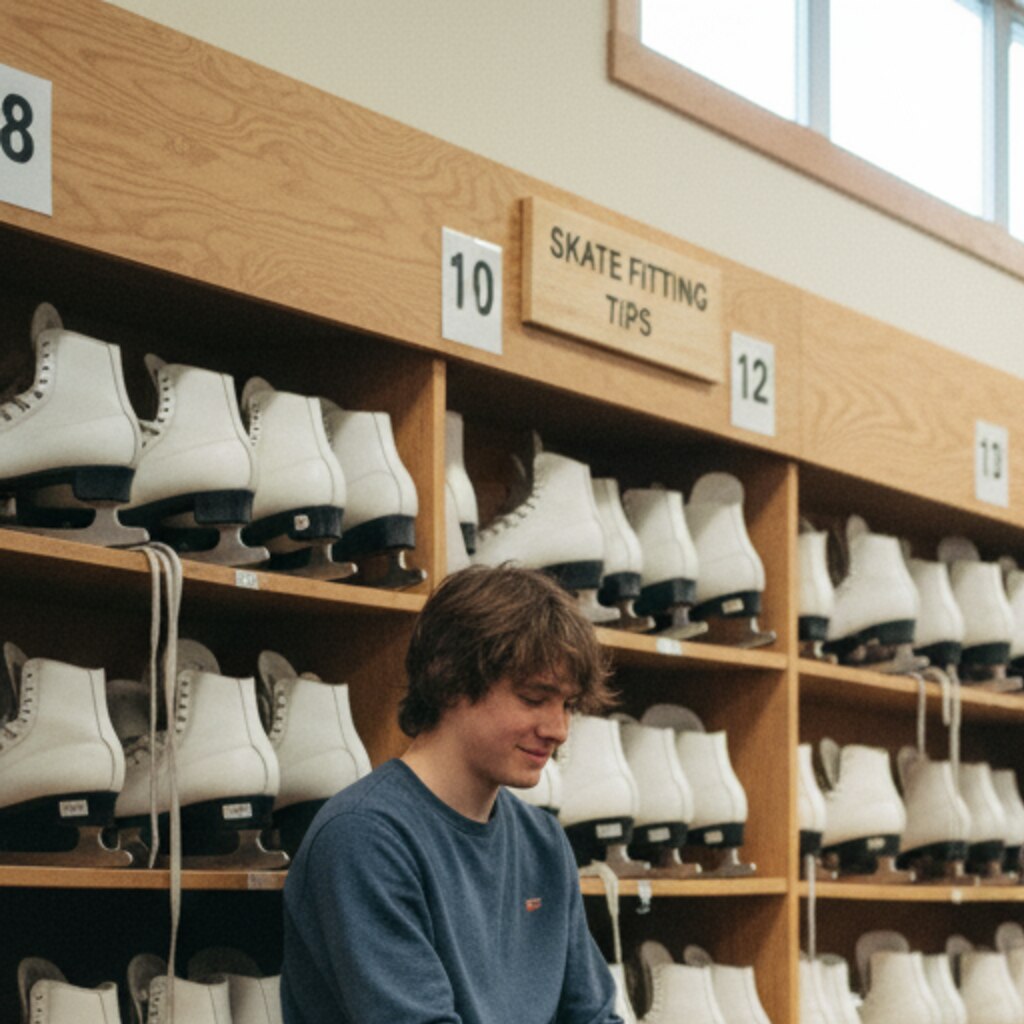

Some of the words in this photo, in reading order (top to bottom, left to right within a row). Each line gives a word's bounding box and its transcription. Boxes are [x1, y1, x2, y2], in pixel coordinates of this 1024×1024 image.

[0, 93, 34, 164] 8
[451, 252, 494, 316] 10
[550, 226, 622, 282] SKATE
[629, 256, 708, 312] FITTING
[605, 294, 652, 336] TIPS
[738, 353, 768, 405] 12
